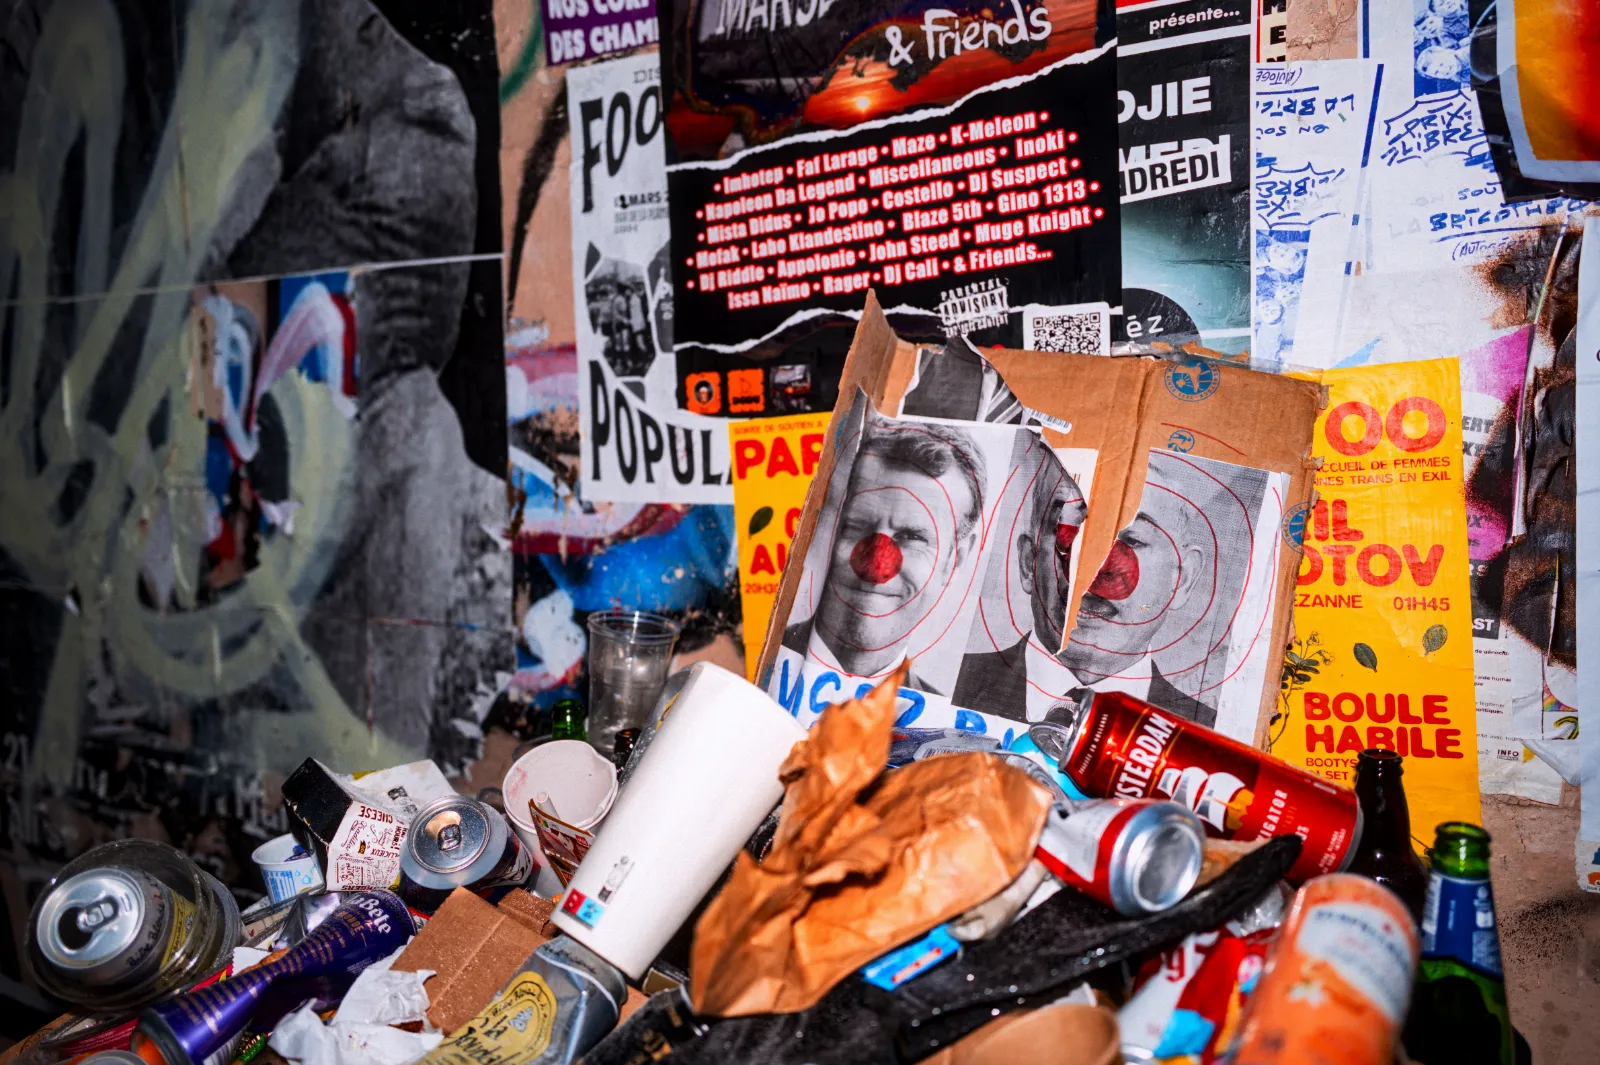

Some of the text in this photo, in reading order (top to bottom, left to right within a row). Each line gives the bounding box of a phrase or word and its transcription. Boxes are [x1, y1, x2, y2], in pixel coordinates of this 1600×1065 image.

[885, 0, 1052, 67] & Friends
[1149, 8, 1240, 35] présente...
[550, 28, 586, 64] DES
[579, 85, 663, 214] FOO
[723, 111, 1037, 195] Imhotep Faf Larage Maze K-Meleon
[704, 192, 774, 222] Napoleon
[774, 187, 796, 207] Da
[798, 172, 856, 202] Legend
[868, 146, 997, 188] Miscellaneous
[1015, 129, 1066, 159] Inoki
[706, 156, 1068, 245] Mista Didus Jo Popo Costello Dj Suspect
[788, 219, 885, 252] Klandestino
[902, 209, 949, 233] Blaze
[951, 199, 983, 223] 5th
[997, 190, 1040, 215] Gino
[1042, 178, 1087, 206] 1313
[699, 206, 1093, 292] Dj Riddle Appolonie John Steed Muge Knight
[727, 289, 760, 310] Issa
[822, 271, 871, 296] Rager
[883, 262, 902, 286] Dj
[904, 256, 939, 281] Cali
[953, 255, 967, 274] &
[968, 243, 1054, 272] Friends...
[940, 277, 1003, 302] PARENTAL
[588, 359, 733, 486] POPUL
[1350, 473, 1394, 485] TRANS
[1400, 472, 1417, 483] EN
[1422, 470, 1452, 482] EXIL
[1371, 460, 1389, 470] DE
[1394, 456, 1451, 468] FEMMES
[1302, 498, 1365, 542] IL
[1393, 596, 1451, 612] 01H45
[1303, 692, 1452, 725] BOULE
[1305, 723, 1465, 760] HABILE
[1496, 749, 1520, 758] INFO
[1325, 770, 1349, 781] SET
[357, 805, 394, 824] CHEESE
